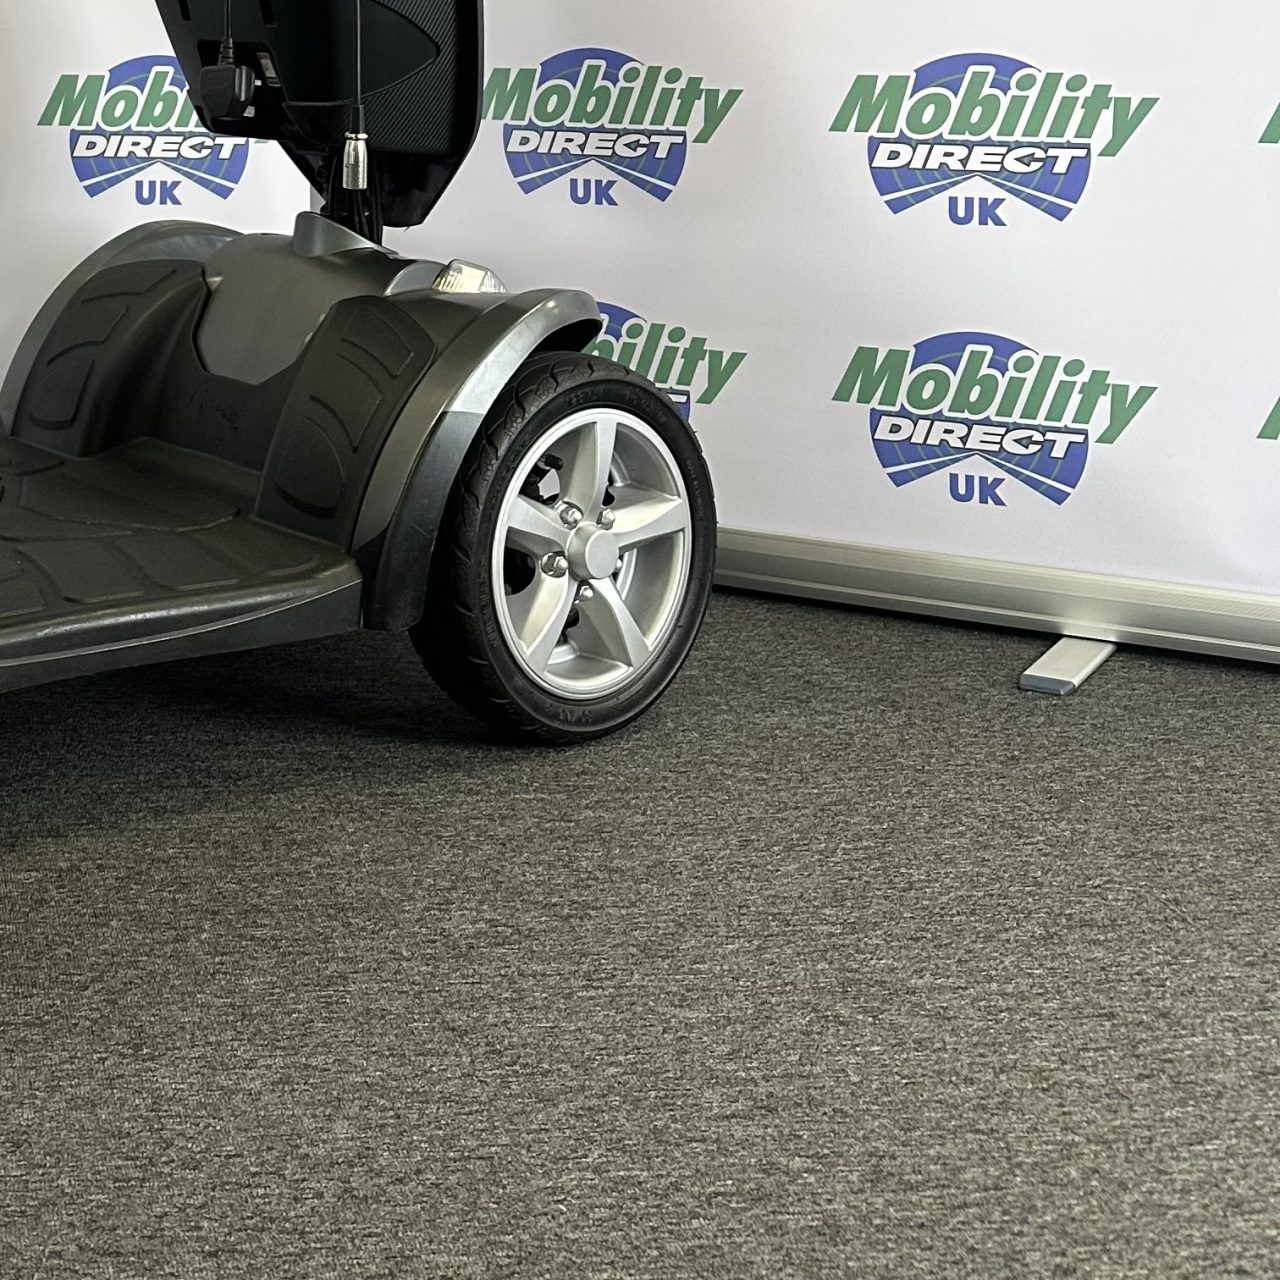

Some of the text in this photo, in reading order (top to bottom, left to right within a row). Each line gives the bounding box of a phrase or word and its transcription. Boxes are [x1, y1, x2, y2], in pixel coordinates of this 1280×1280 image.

[483, 60, 744, 144] Mobility
[828, 68, 1160, 158] Mobility
[72, 135, 249, 159] DIRECT
[505, 129, 688, 160] DIRECT
[870, 144, 1090, 176] DIRECT
[135, 180, 182, 206] UK
[568, 177, 619, 207] UK
[947, 195, 1007, 227] UK
[585, 323, 748, 405] ility
[831, 344, 1158, 445] Mobility
[873, 417, 1087, 459] DIRECT
[948, 473, 1007, 507] UK
